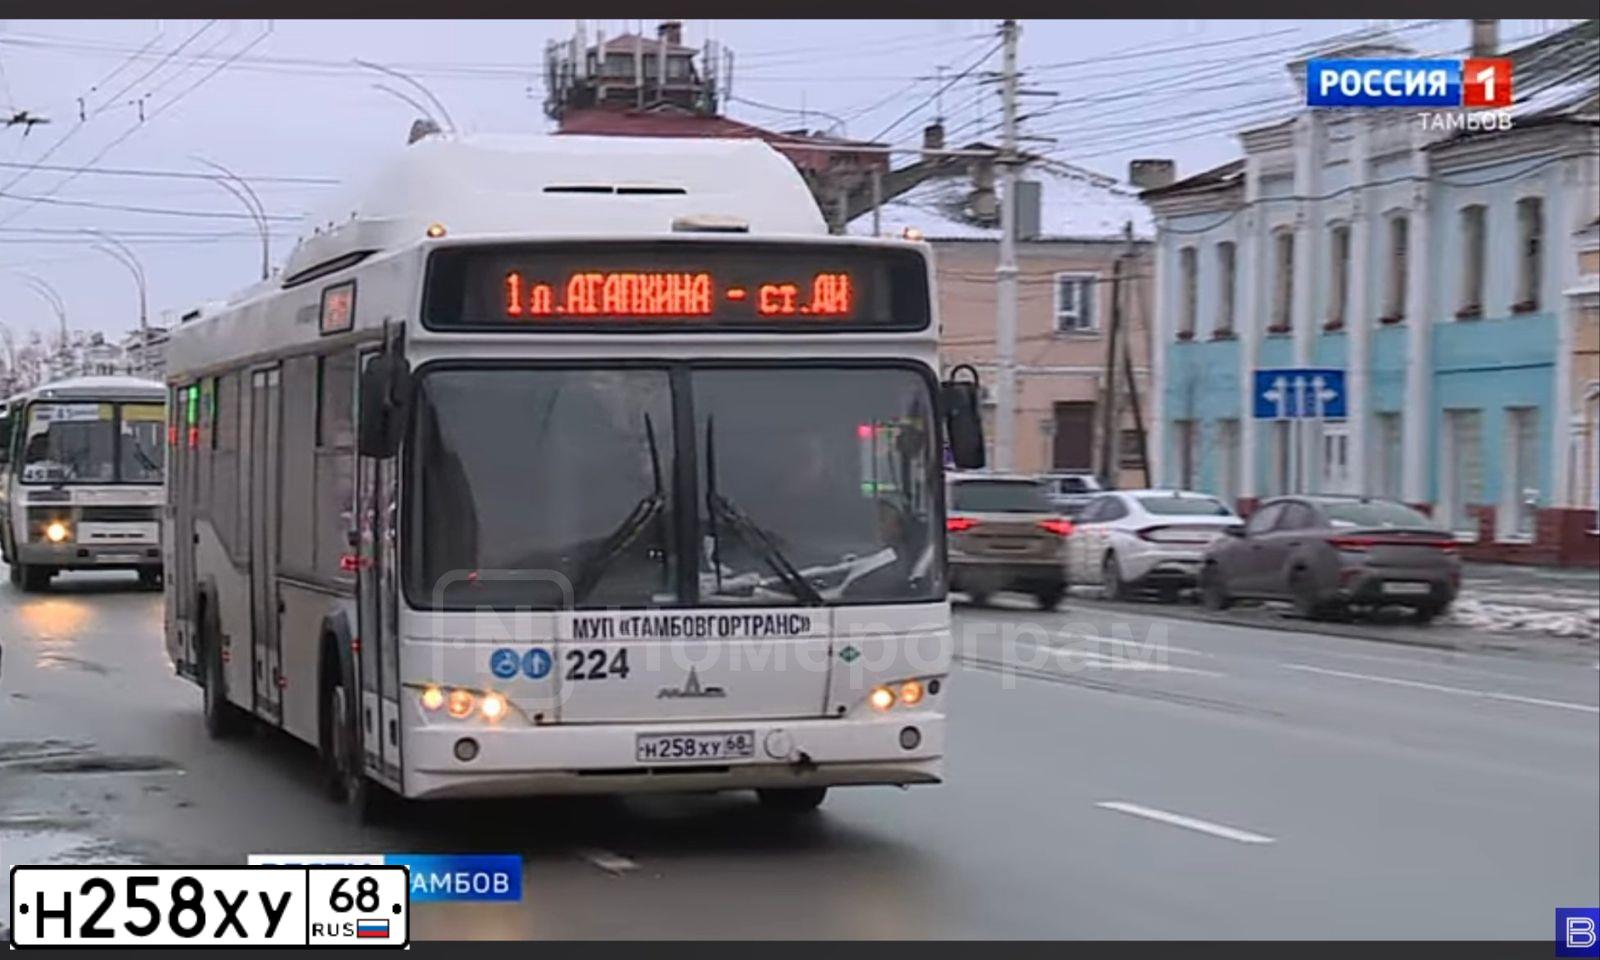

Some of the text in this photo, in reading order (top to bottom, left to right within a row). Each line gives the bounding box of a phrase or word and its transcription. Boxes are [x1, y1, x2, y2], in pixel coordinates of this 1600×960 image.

[507, 273, 522, 315] 1
[572, 613, 811, 639] МУП «ТАМБОВГОРТРАНС»
[565, 648, 630, 681] 224
